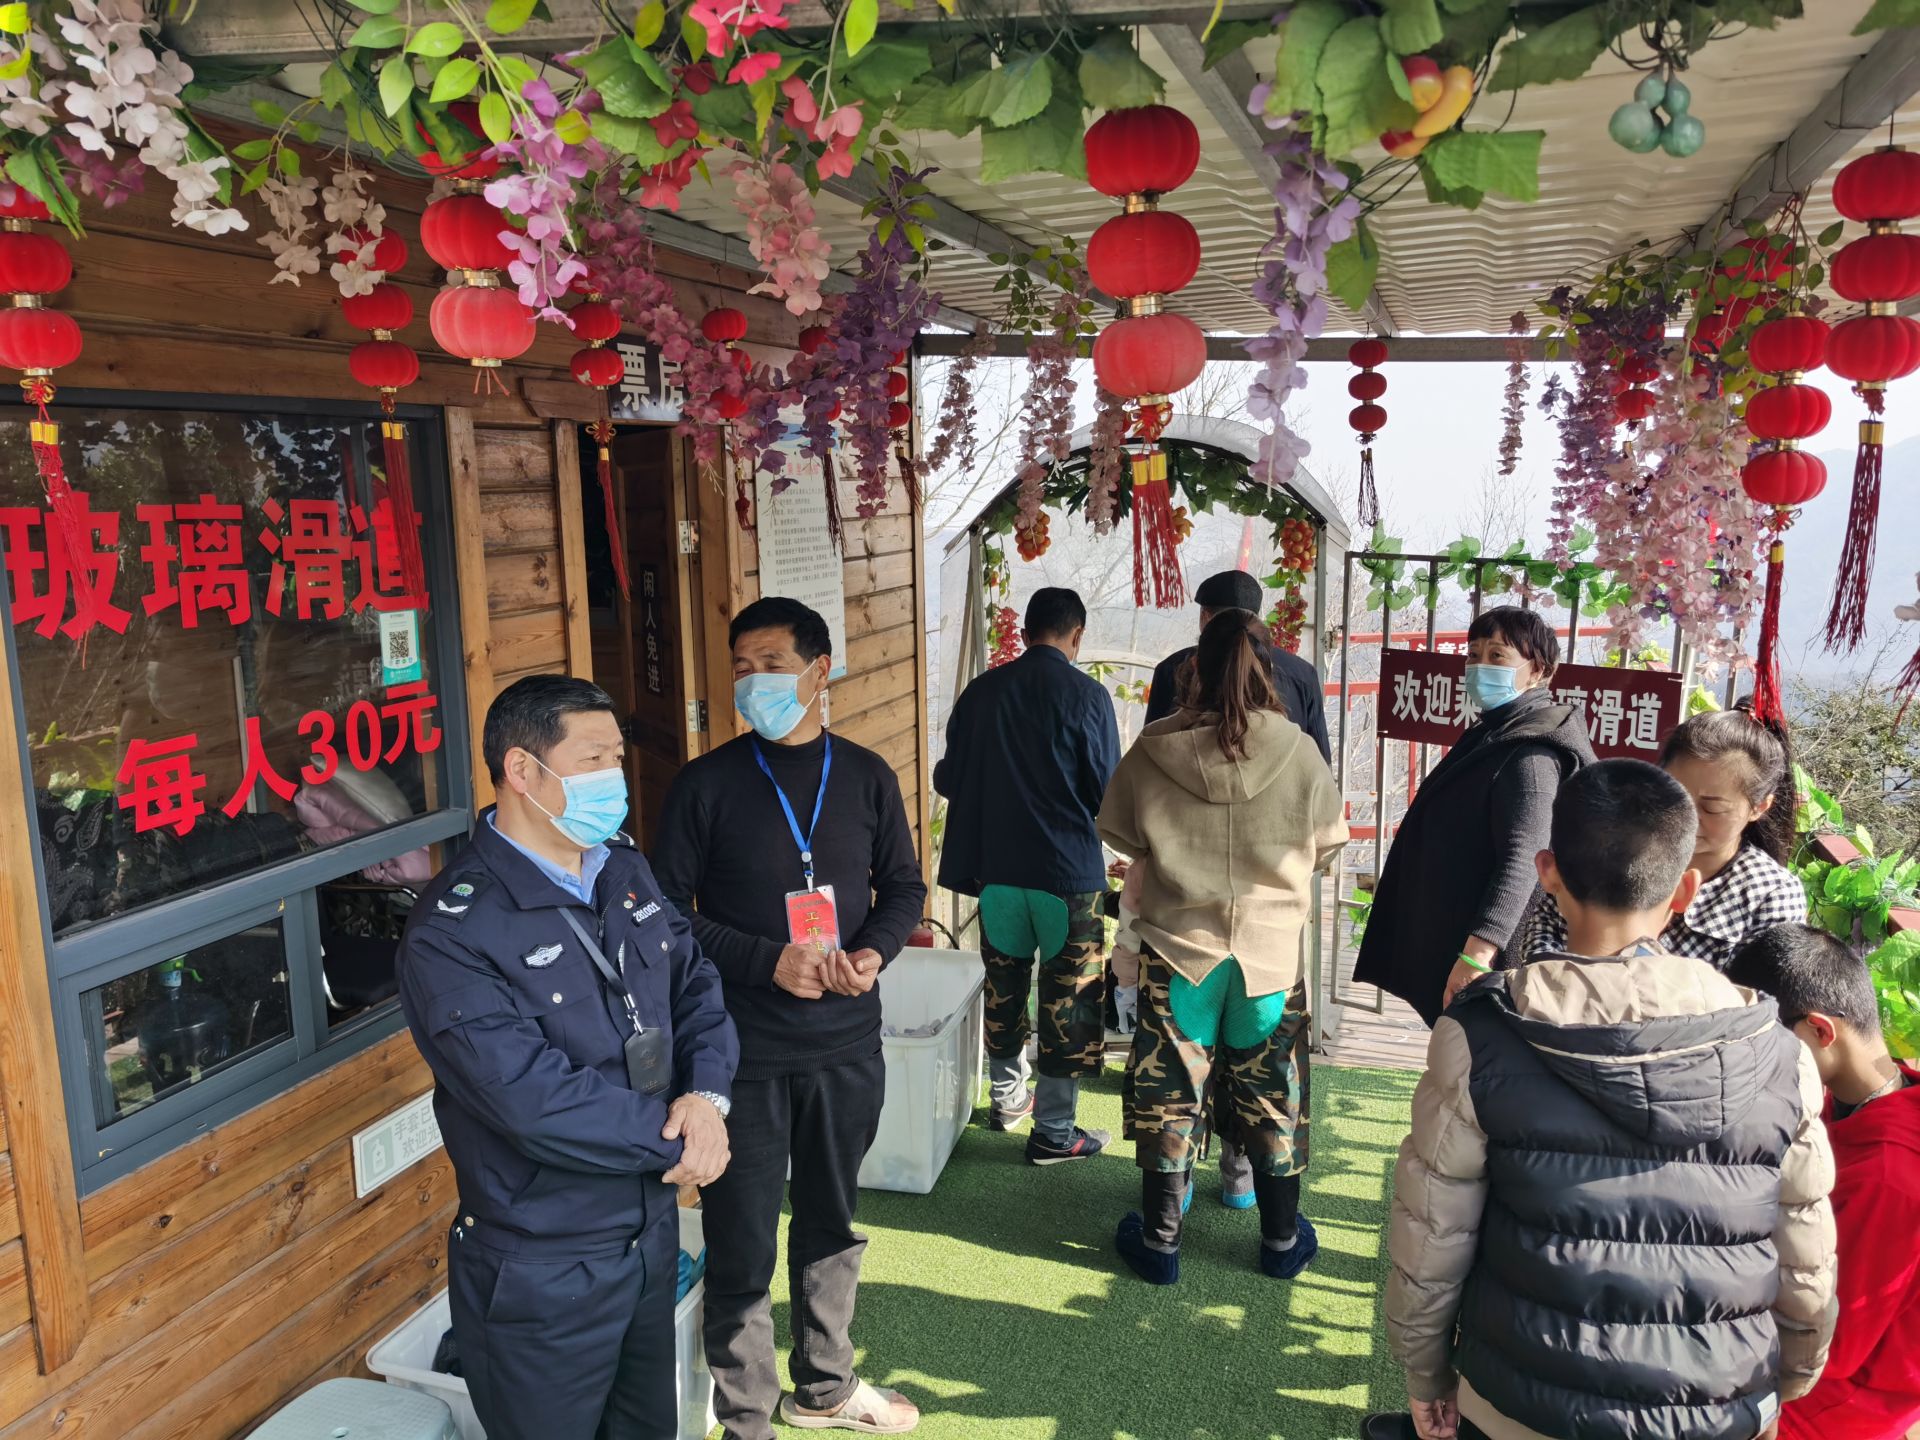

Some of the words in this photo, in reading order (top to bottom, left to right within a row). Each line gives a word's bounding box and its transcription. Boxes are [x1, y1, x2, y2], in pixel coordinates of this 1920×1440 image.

[617, 343, 684, 414] 票房
[0, 492, 431, 640] 玻璃滑道
[643, 570, 661, 693] 闲人免进
[116, 680, 442, 838] 每人30元
